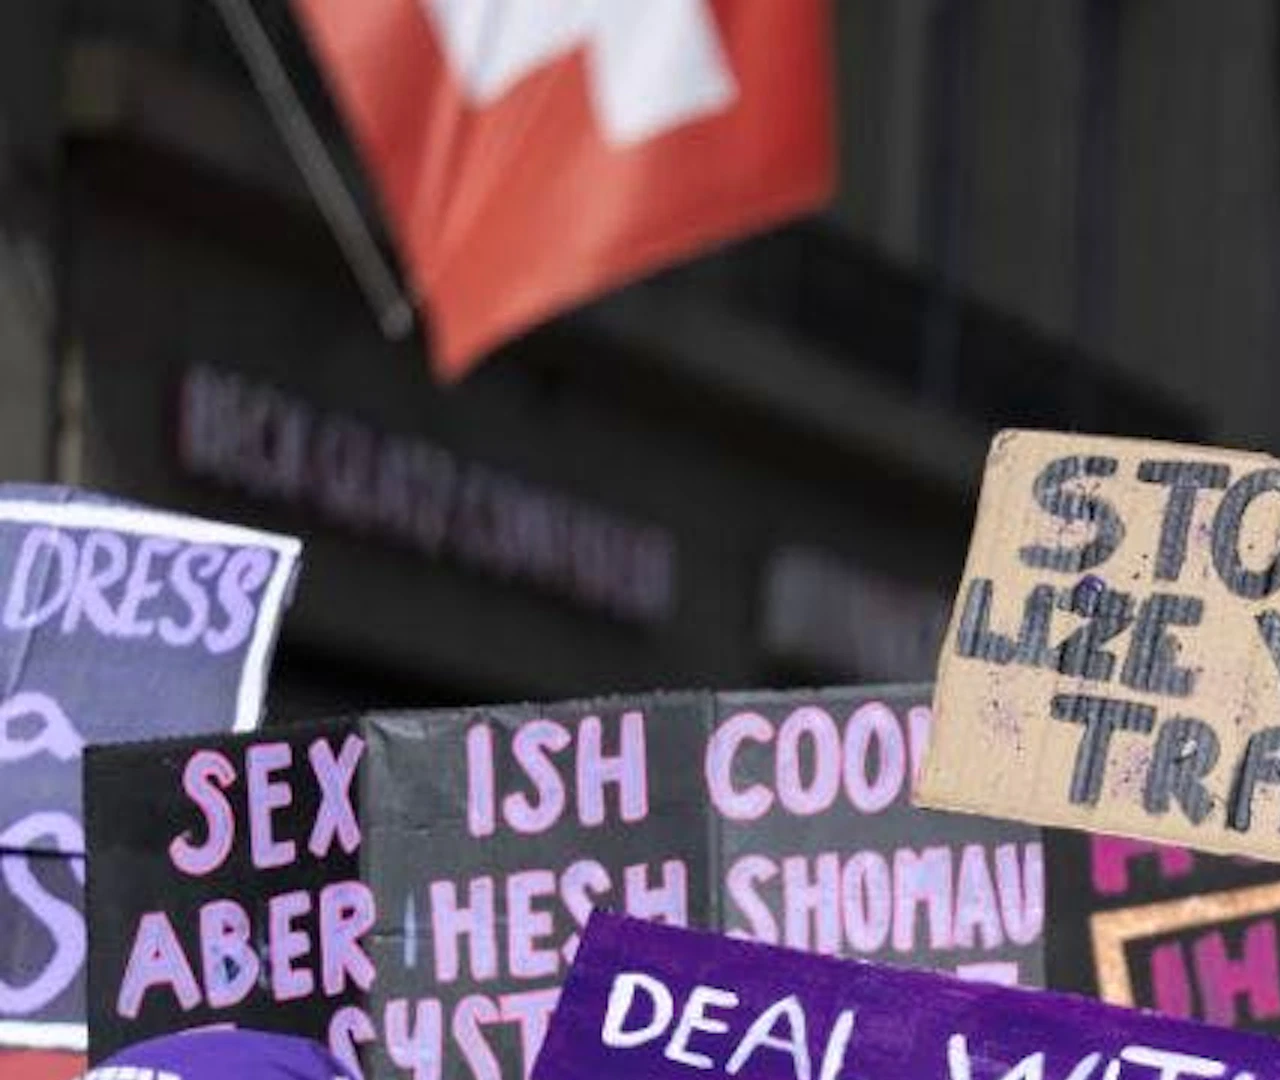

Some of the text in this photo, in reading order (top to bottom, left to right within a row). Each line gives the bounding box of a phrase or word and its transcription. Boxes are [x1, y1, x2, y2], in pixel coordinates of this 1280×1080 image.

[2, 526, 272, 655] DRESS
[168, 735, 368, 877] SEX
[466, 712, 649, 838] ISH
[116, 879, 377, 1019] ABER
